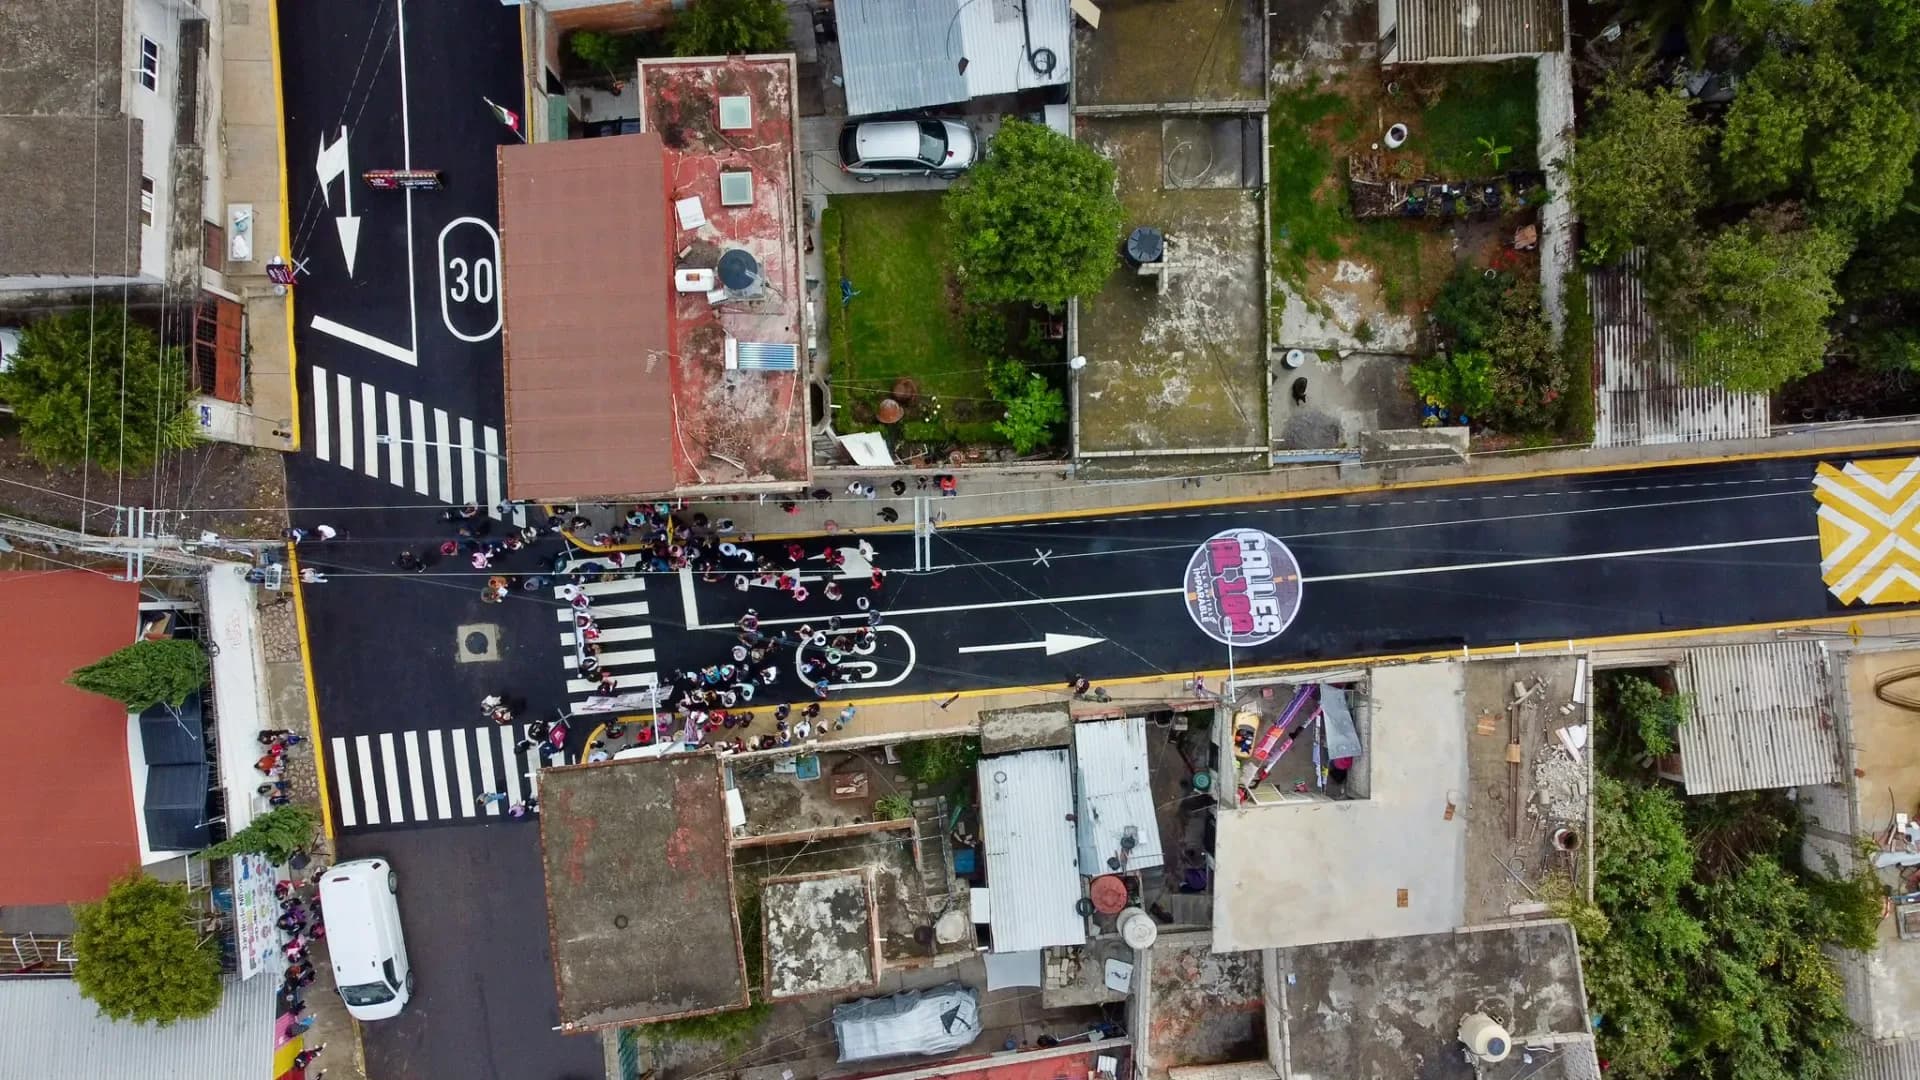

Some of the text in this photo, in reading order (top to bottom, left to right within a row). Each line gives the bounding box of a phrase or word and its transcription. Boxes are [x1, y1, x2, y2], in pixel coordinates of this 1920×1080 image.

[450, 257, 493, 303] 30
[1193, 567, 1210, 622] IMPARABLE
[1237, 532, 1281, 633] CALLES
